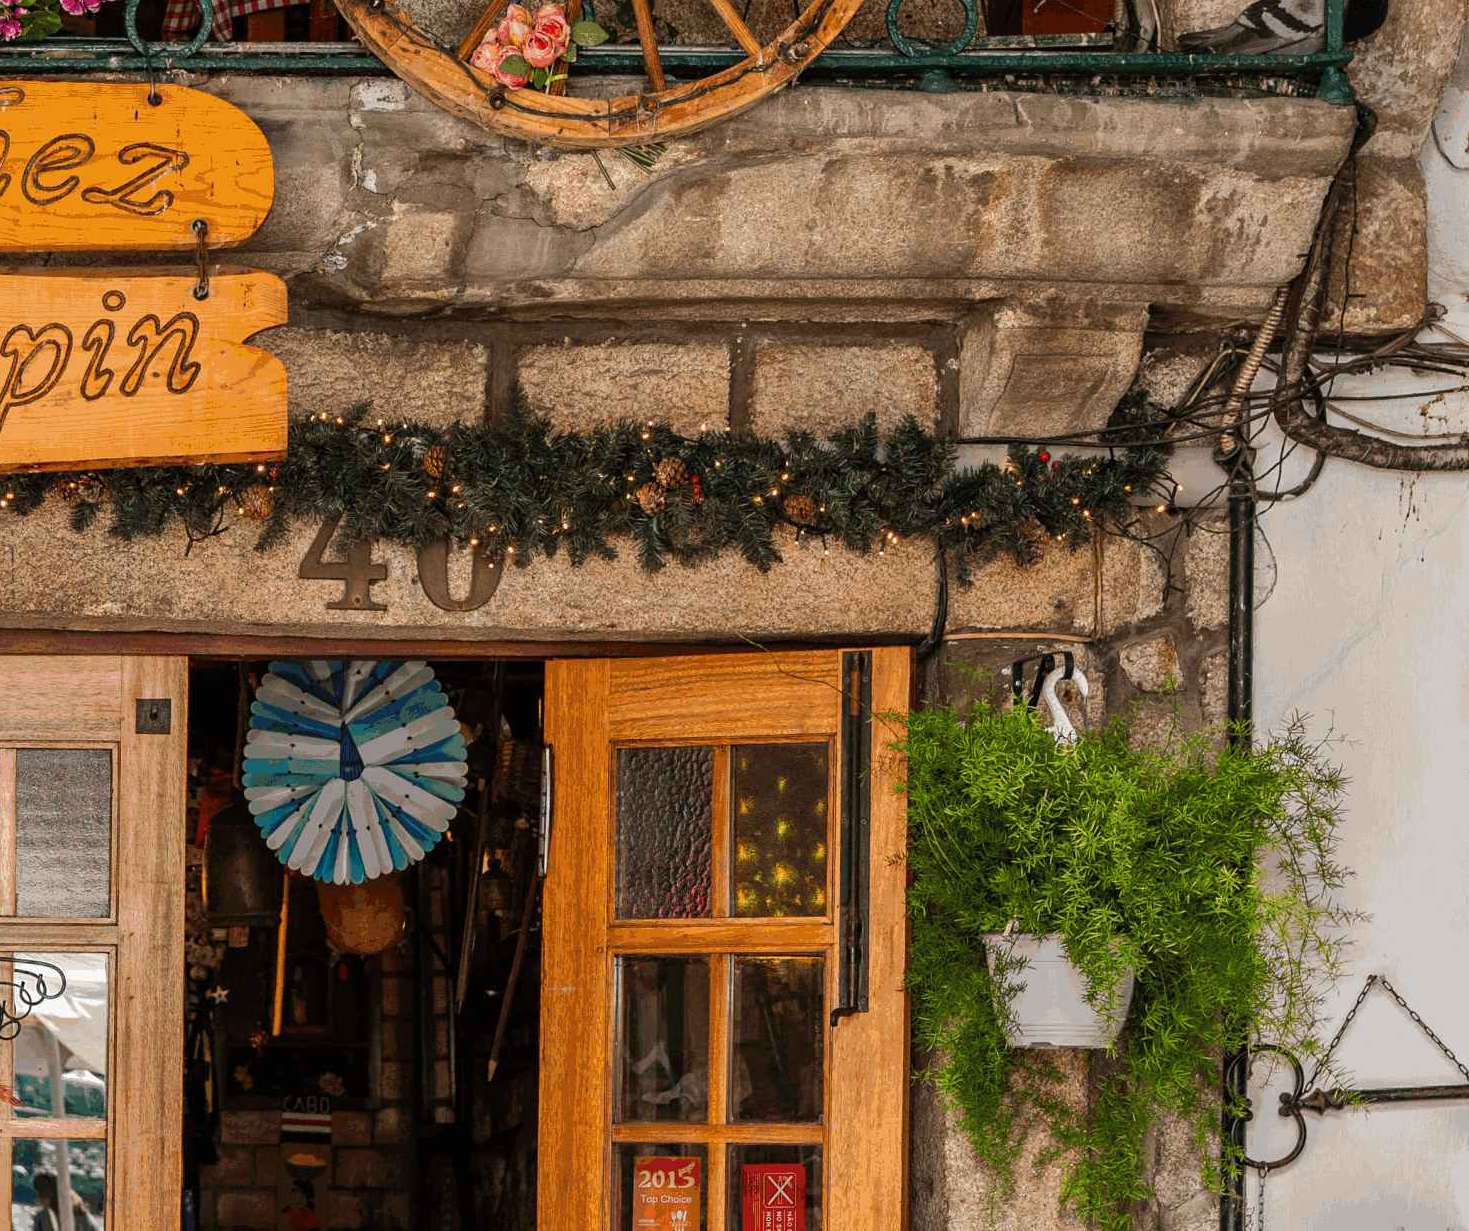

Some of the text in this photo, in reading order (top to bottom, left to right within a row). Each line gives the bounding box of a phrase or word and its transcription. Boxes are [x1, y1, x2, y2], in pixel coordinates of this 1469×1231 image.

[299, 512, 504, 612] 40
[638, 1164, 695, 1189] 2015
[640, 1194, 693, 1206] Top Choice
[776, 1211, 783, 1222] NO
